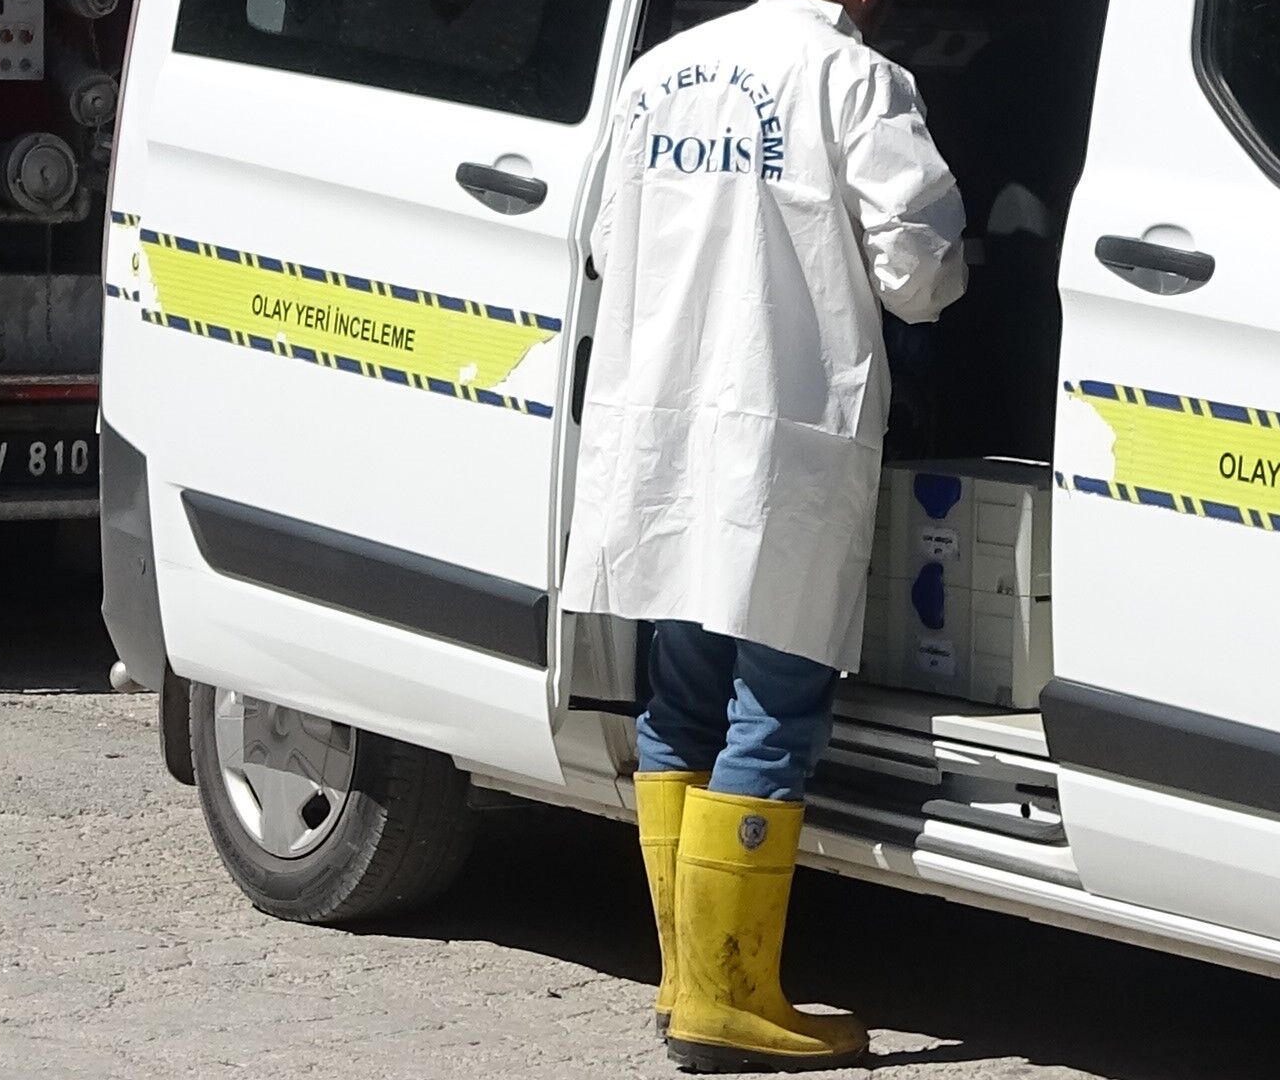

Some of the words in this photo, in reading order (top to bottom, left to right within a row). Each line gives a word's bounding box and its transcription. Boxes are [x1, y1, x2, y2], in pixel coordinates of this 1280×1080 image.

[647, 126, 755, 175] POLİS
[251, 293, 293, 323] OLAY
[295, 303, 332, 333] YERİ
[333, 306, 417, 352] İNCELEME
[28, 439, 89, 475] 810
